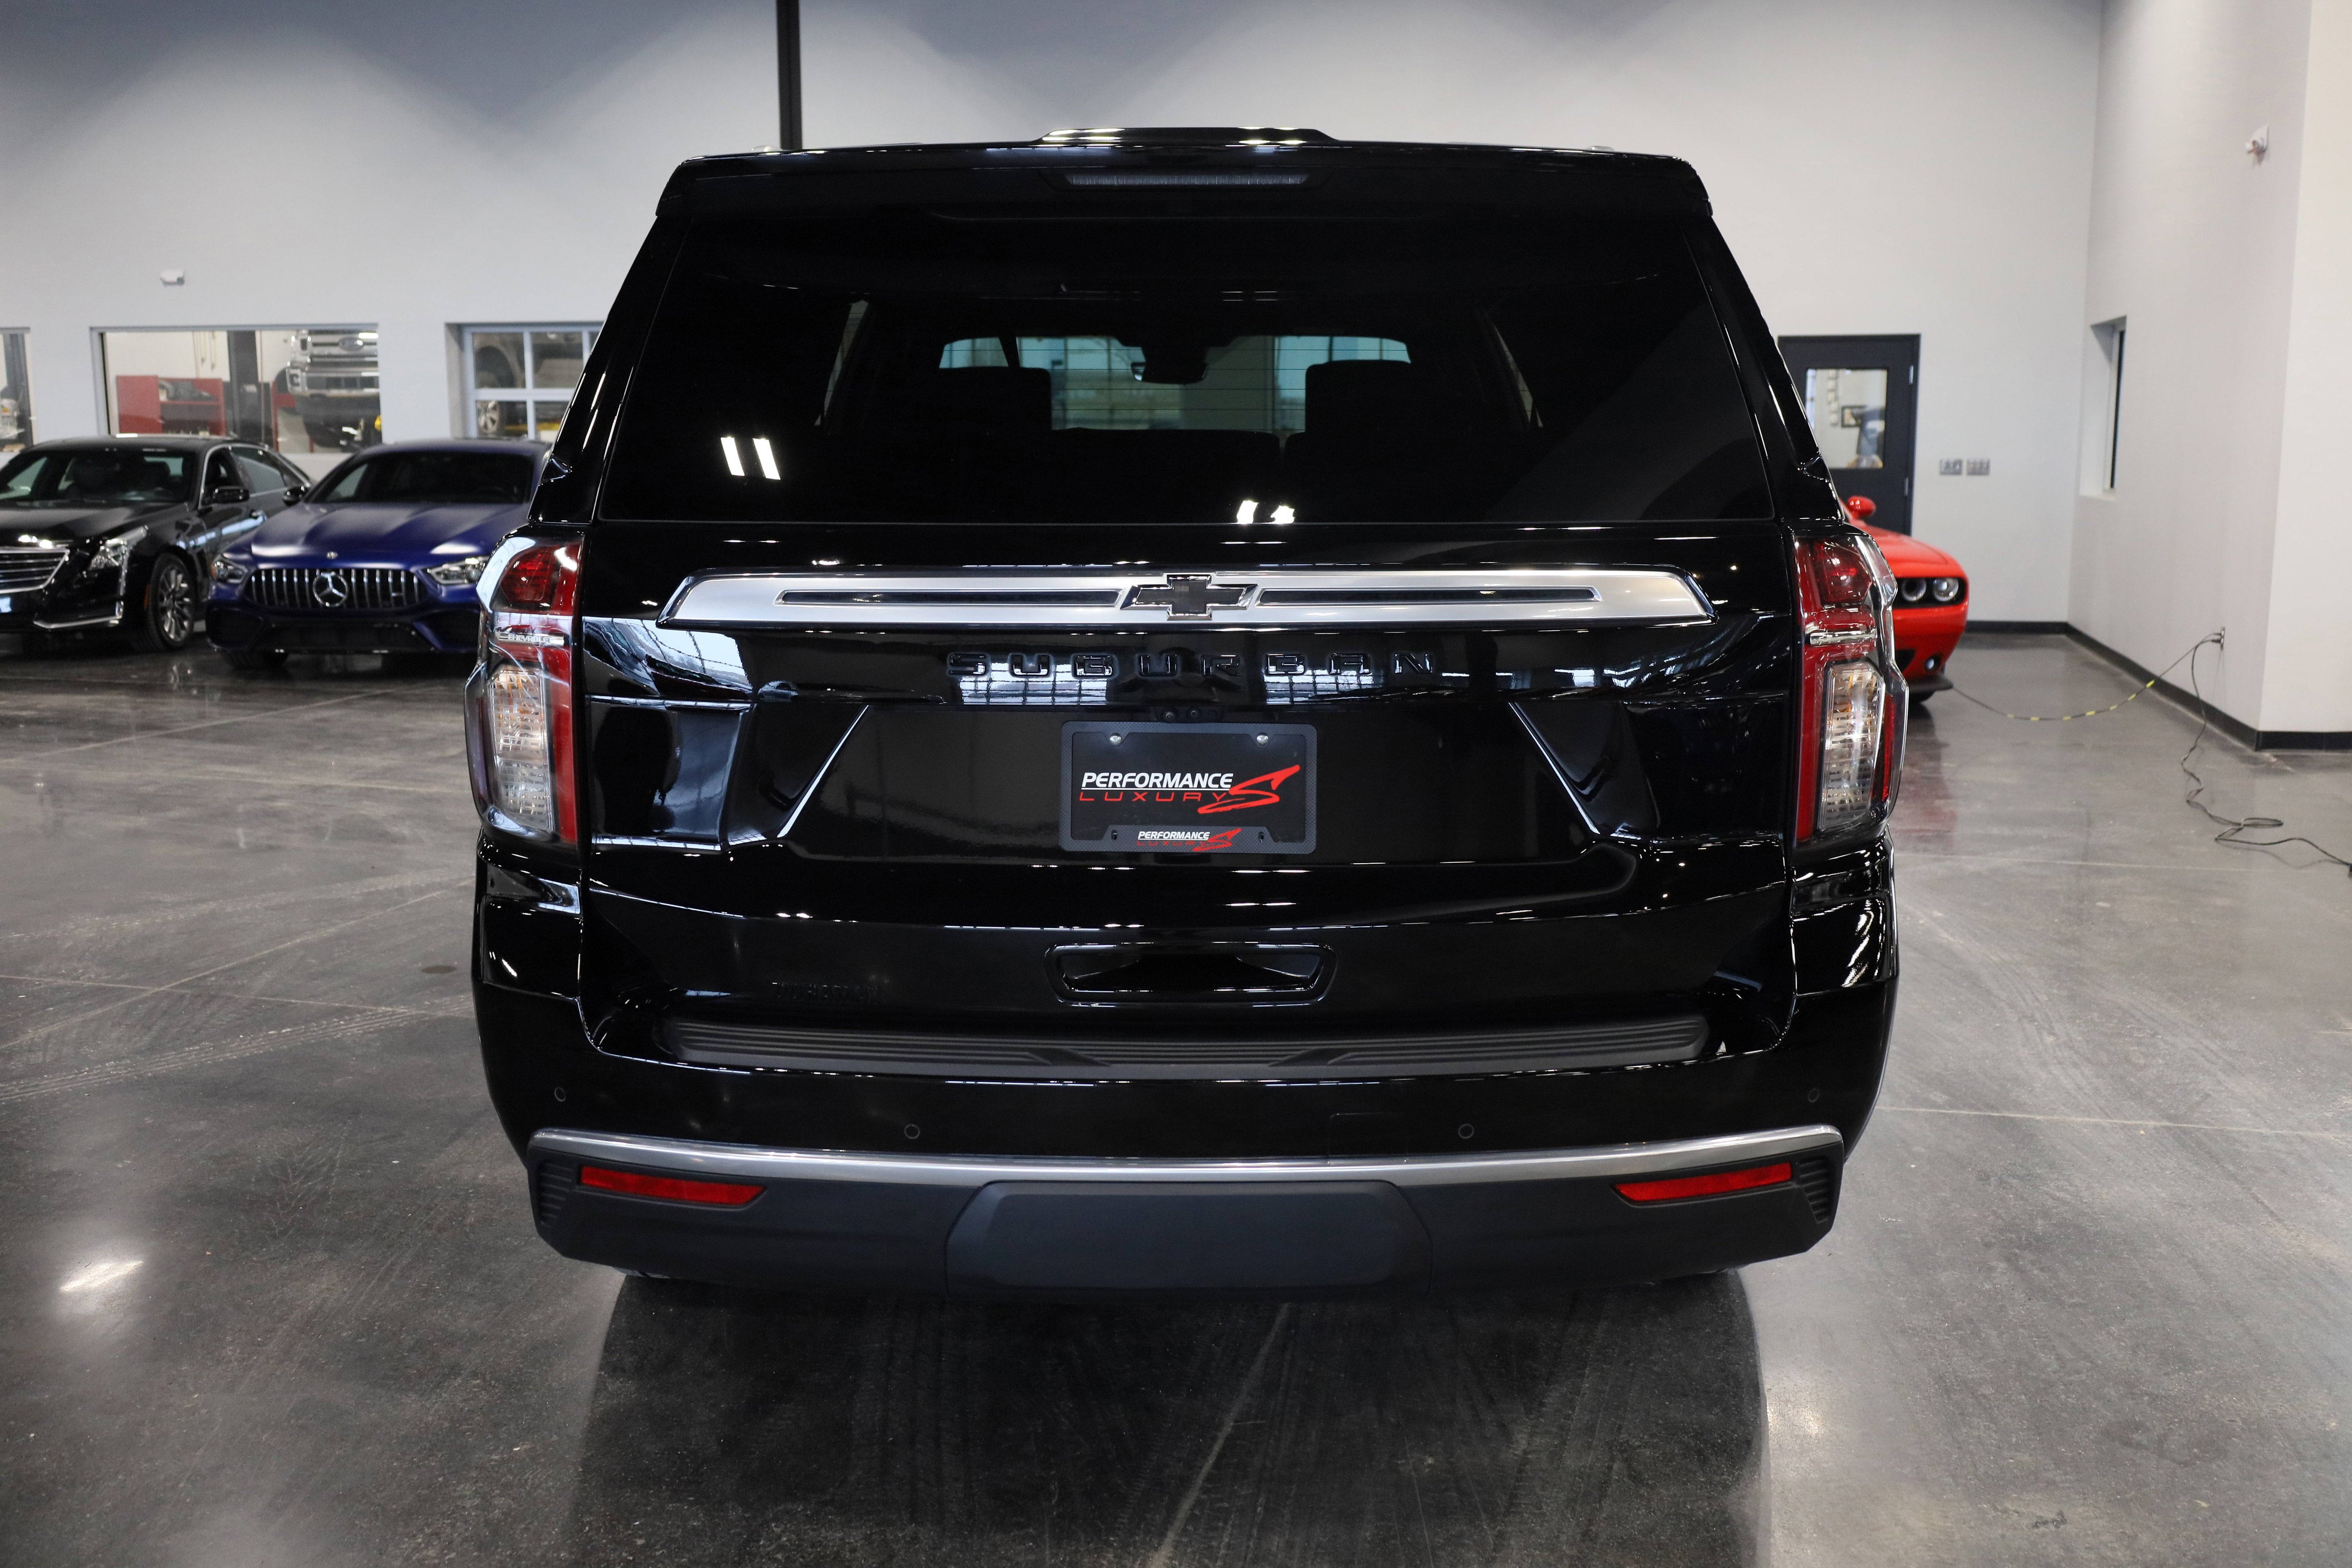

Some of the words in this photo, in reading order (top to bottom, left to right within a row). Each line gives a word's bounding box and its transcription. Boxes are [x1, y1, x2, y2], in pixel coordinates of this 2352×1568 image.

[947, 653, 1433, 676] SUBURBAN
[1081, 772, 1234, 788] PERFORMANCE
[1079, 792, 1227, 802] LUXURY
[1138, 831, 1210, 840] PERFORMANCE
